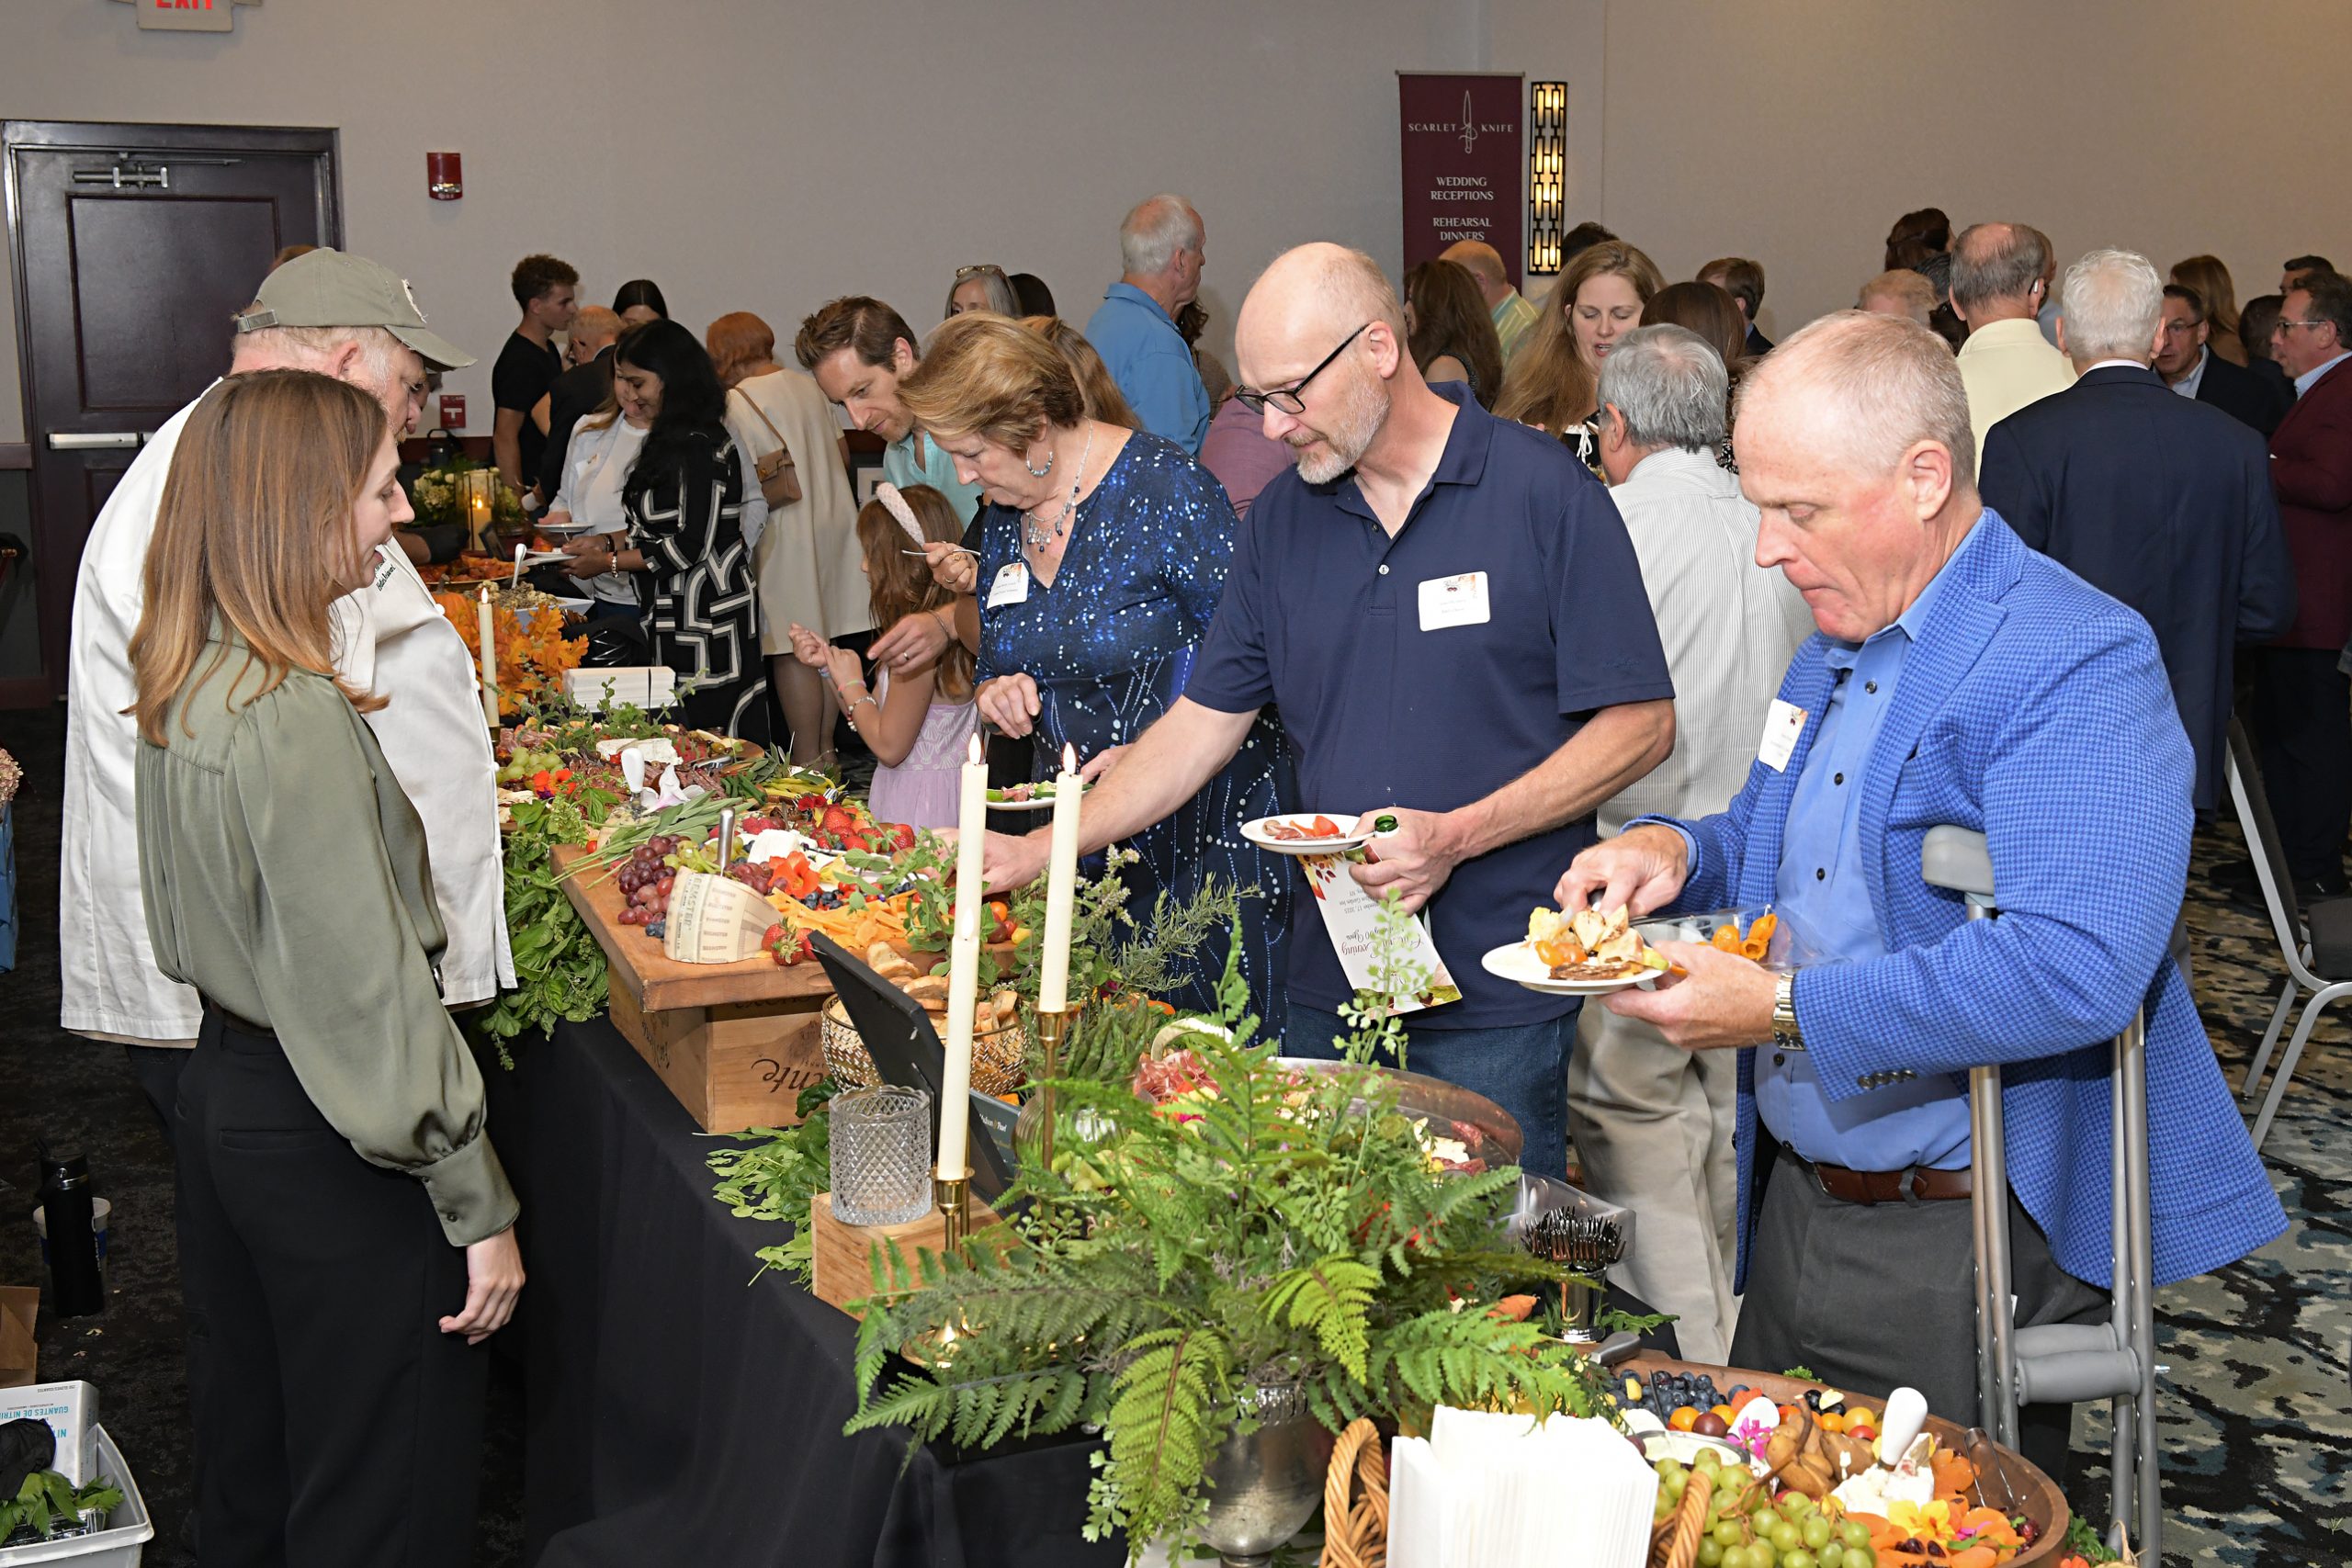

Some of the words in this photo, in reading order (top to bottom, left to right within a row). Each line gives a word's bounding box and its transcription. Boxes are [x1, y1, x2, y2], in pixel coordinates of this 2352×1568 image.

[1408, 123, 1457, 132] SCARLET
[1481, 124, 1513, 132] KNIFE
[1436, 176, 1487, 186] WEDDING
[1430, 190, 1494, 201] RECEPTIONS
[1433, 218, 1492, 228] REHEARSAL
[1440, 231, 1485, 242] DINNERS
[24, 1409, 32, 1417] DE
[35, 1405, 69, 1416] GUANTES
